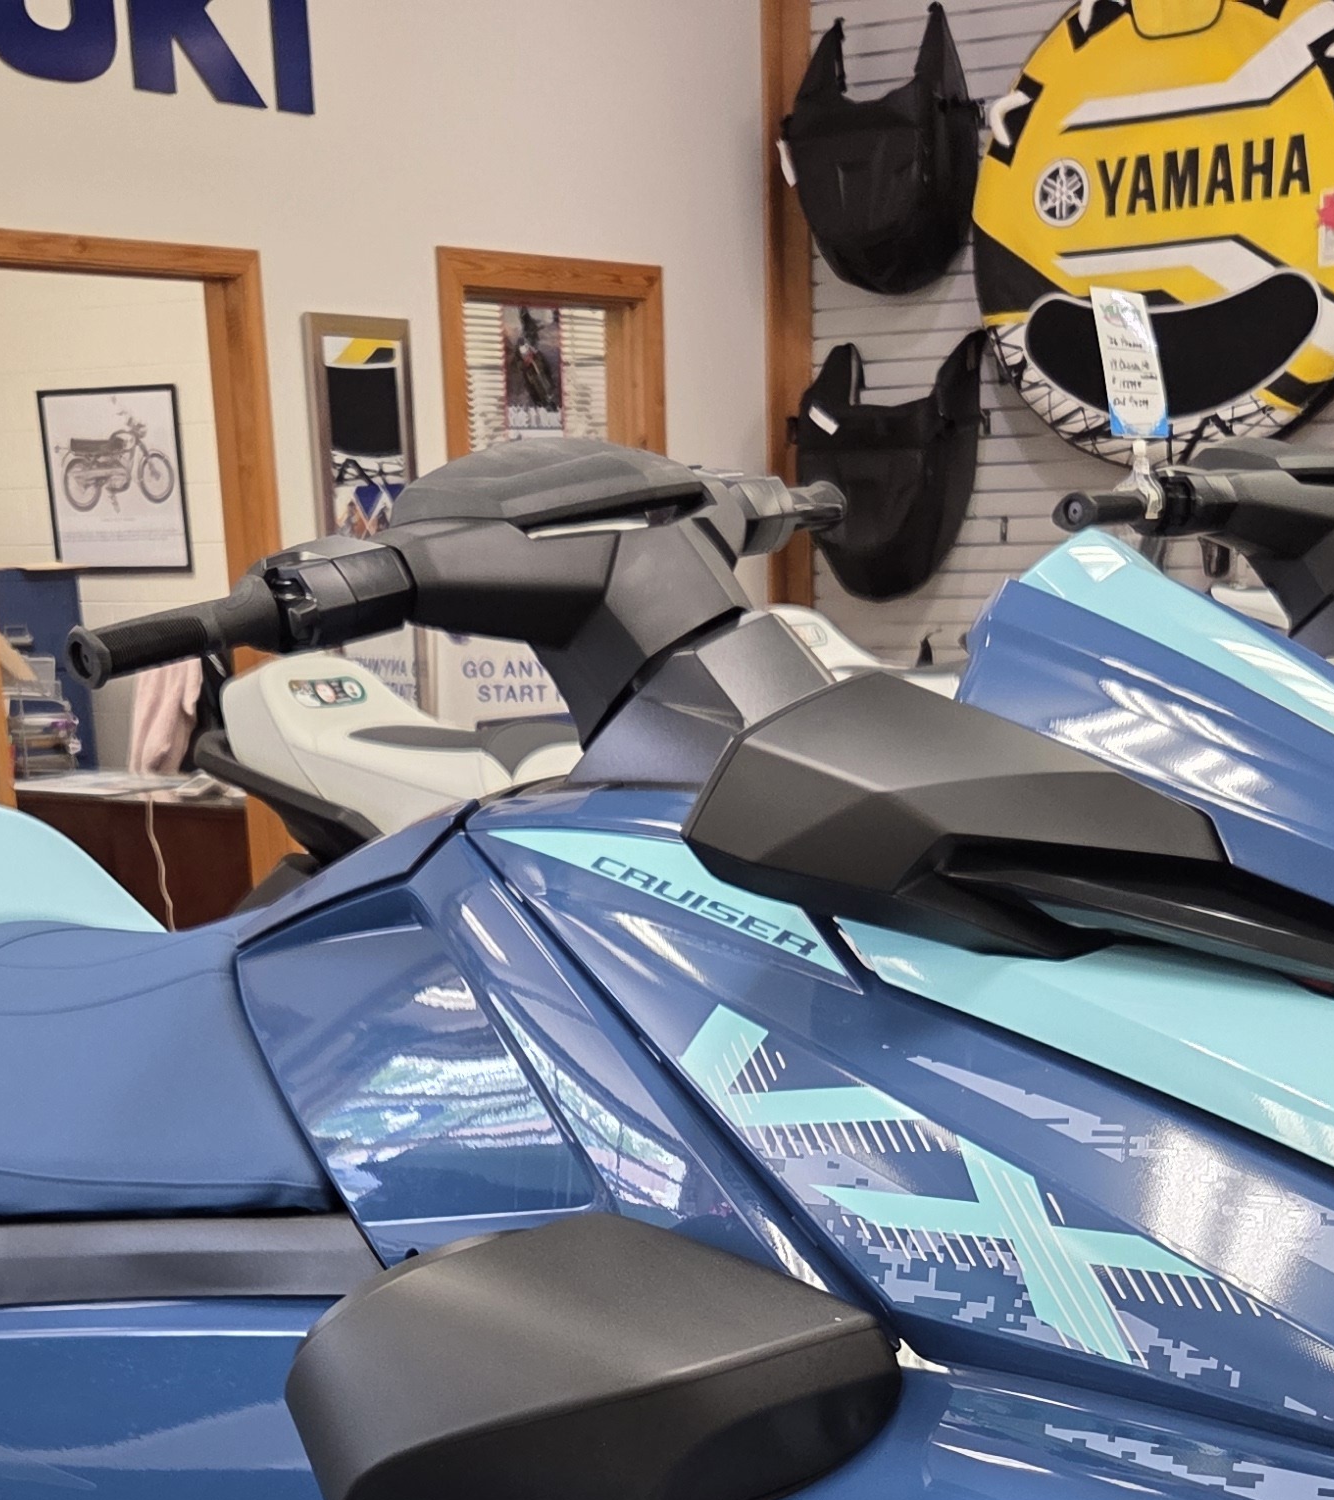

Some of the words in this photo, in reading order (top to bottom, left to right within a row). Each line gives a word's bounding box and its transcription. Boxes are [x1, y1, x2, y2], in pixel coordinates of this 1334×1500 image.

[1097, 134, 1311, 217] YAMAHA
[462, 661, 495, 679] GO
[477, 685, 548, 703] START
[590, 855, 819, 957] CRUISER
